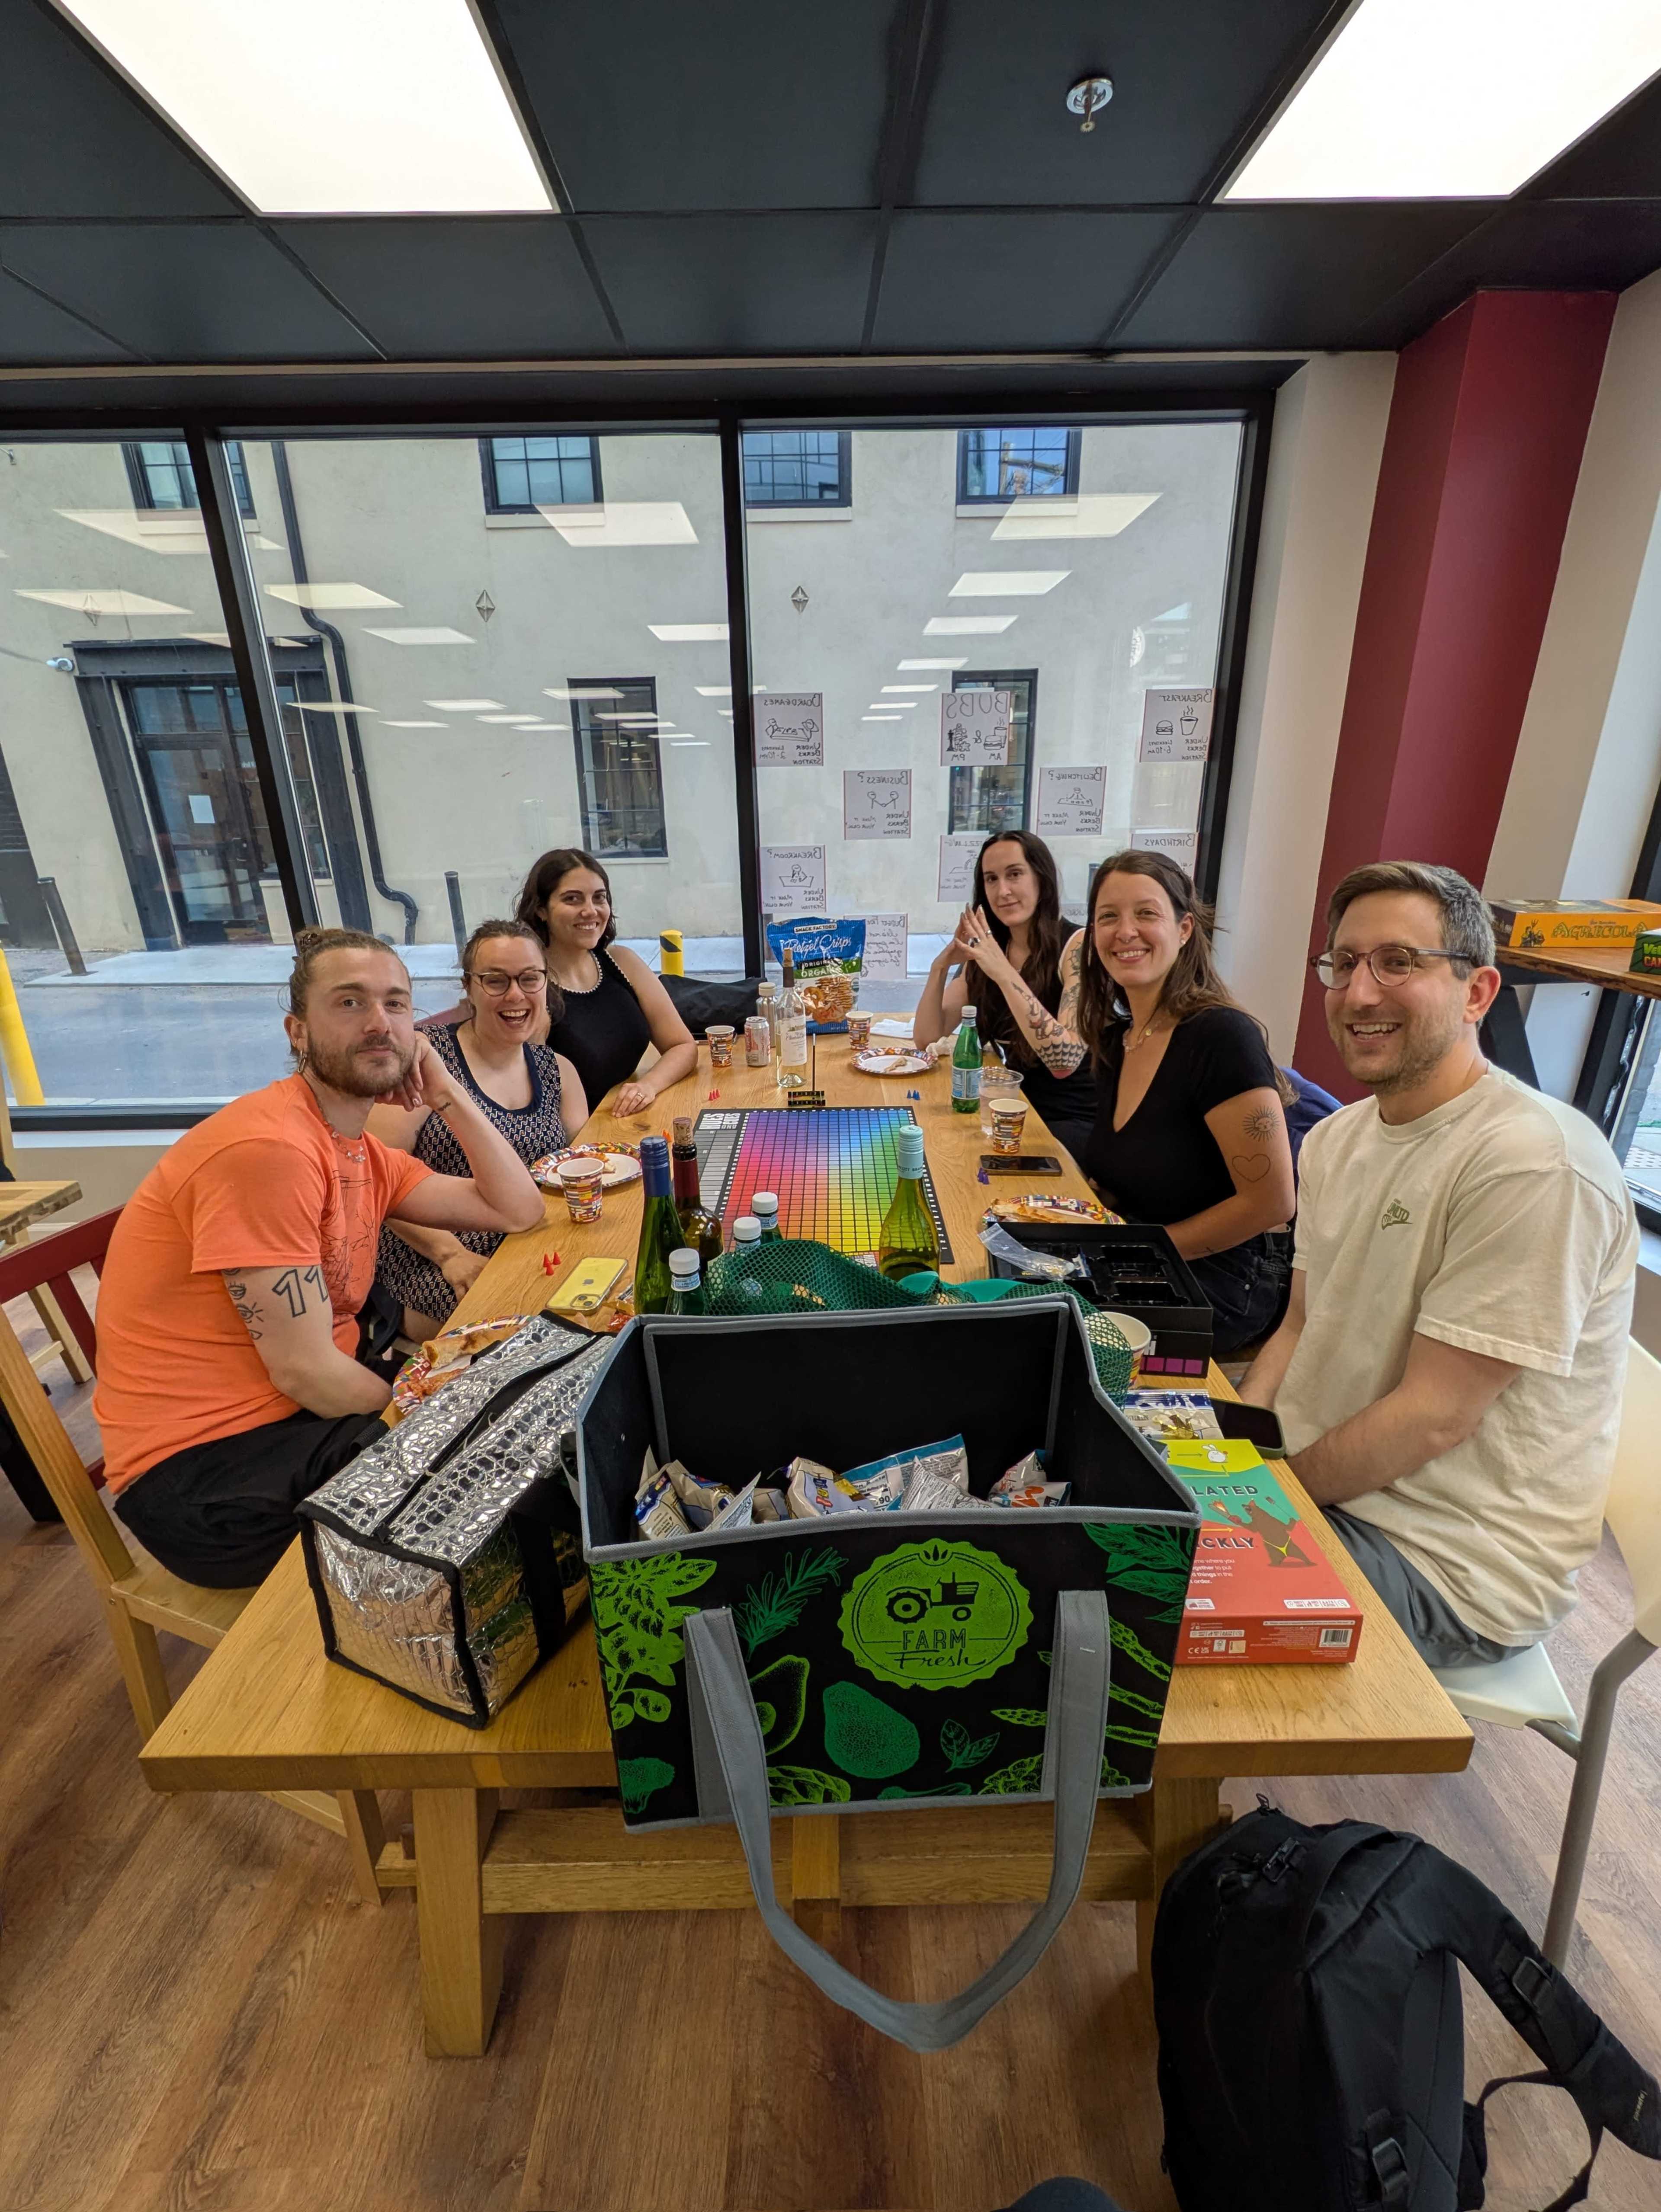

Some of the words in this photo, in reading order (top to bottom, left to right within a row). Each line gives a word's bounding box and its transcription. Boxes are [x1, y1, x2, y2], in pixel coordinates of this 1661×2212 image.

[699, 1113, 725, 1129] HUES
[879, 1495, 890, 1504] 90
[903, 1628, 966, 1651] FARM
[885, 1649, 987, 1669] Fresh
